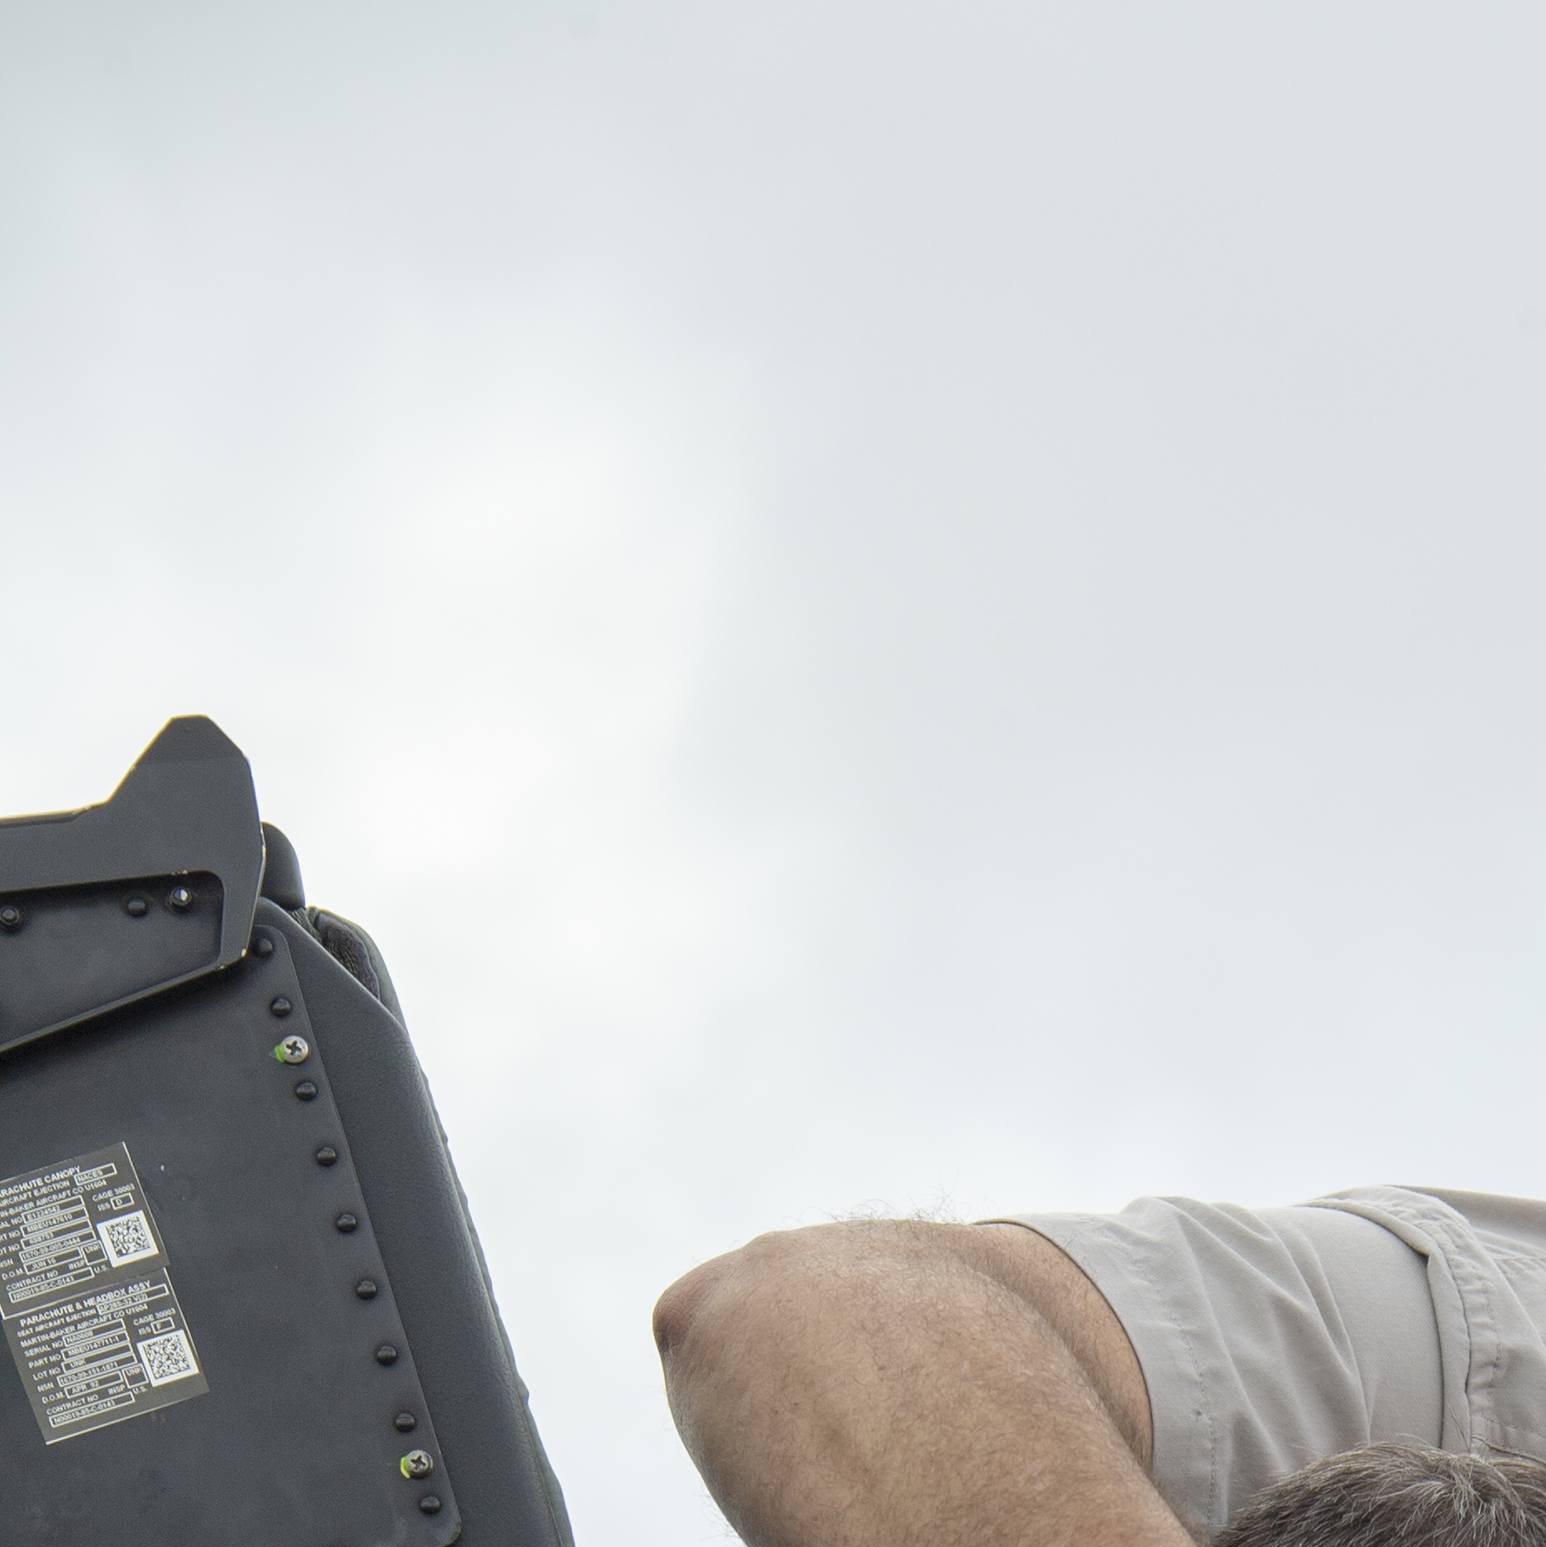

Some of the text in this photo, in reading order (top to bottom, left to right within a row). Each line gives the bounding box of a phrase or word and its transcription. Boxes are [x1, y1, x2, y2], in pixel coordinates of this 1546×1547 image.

[43, 1166, 81, 1184] CANOPY
[33, 1181, 70, 1197] EJECTION
[35, 1191, 72, 1207] AIRCRAFT
[72, 1187, 84, 1196] CO
[84, 1180, 107, 1192] U1604
[92, 1184, 135, 1202] CAGE 30003
[97, 1203, 111, 1212] ISS
[11, 1217, 23, 1226] NO
[8, 1230, 20, 1239] NO
[8, 1244, 20, 1253] NO
[31, 1262, 47, 1271] JUN
[68, 1260, 87, 1271] INSP
[5, 1271, 59, 1292] CONTRACT NO
[20, 1281, 151, 1328] PARACHUTE & HEADBOX ASSY
[17, 1329, 34, 1339] SEAT
[34, 1319, 66, 1333] AIRCRAFT
[65, 1309, 97, 1323] EJECTION
[132, 1308, 176, 1326] CAGE 30003
[20, 1304, 148, 1349] MARTIN-BAKER AIRCRAFT CO U1604
[138, 1327, 152, 1336] ISS
[24, 1345, 51, 1359] SERIAL
[51, 1341, 64, 1350] NO
[28, 1359, 49, 1370] PART
[49, 1355, 62, 1364] NO
[32, 1359, 87, 1382] LOT NO UNK
[36, 1383, 54, 1394] NSN
[71, 1386, 88, 1395] APR
[108, 1385, 126, 1396] INSP
[45, 1395, 99, 1416] CONTRACT NO
